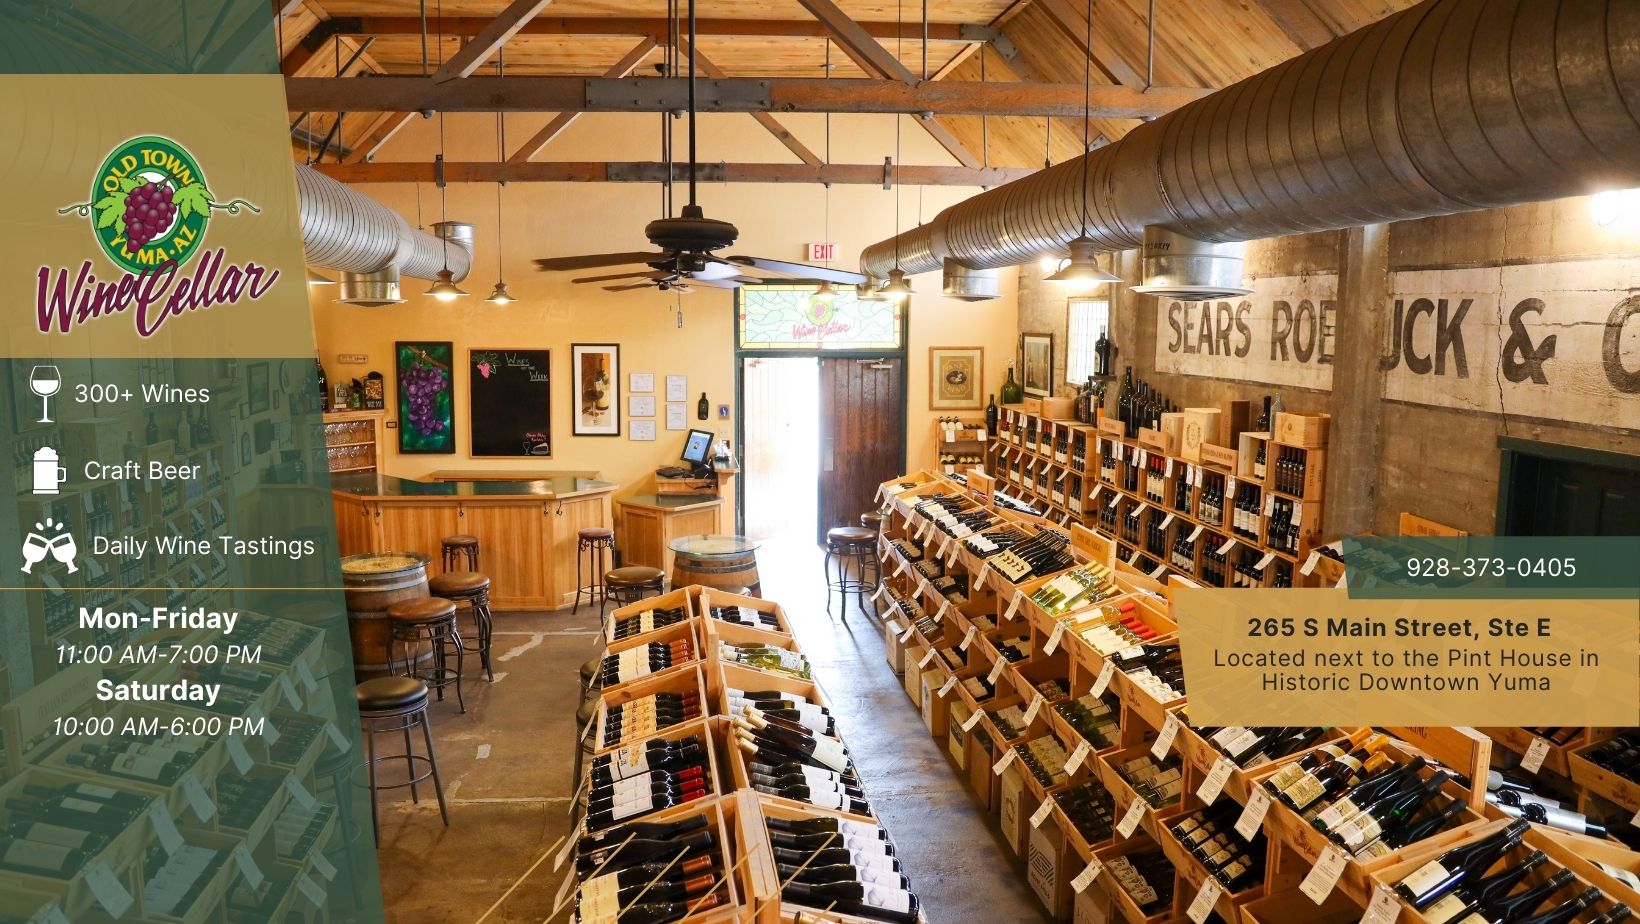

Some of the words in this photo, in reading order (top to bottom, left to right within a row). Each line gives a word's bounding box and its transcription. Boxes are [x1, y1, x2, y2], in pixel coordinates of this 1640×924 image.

[813, 244, 834, 260] EXIT
[1168, 299, 1252, 359] SEARS
[1502, 297, 1557, 385] &
